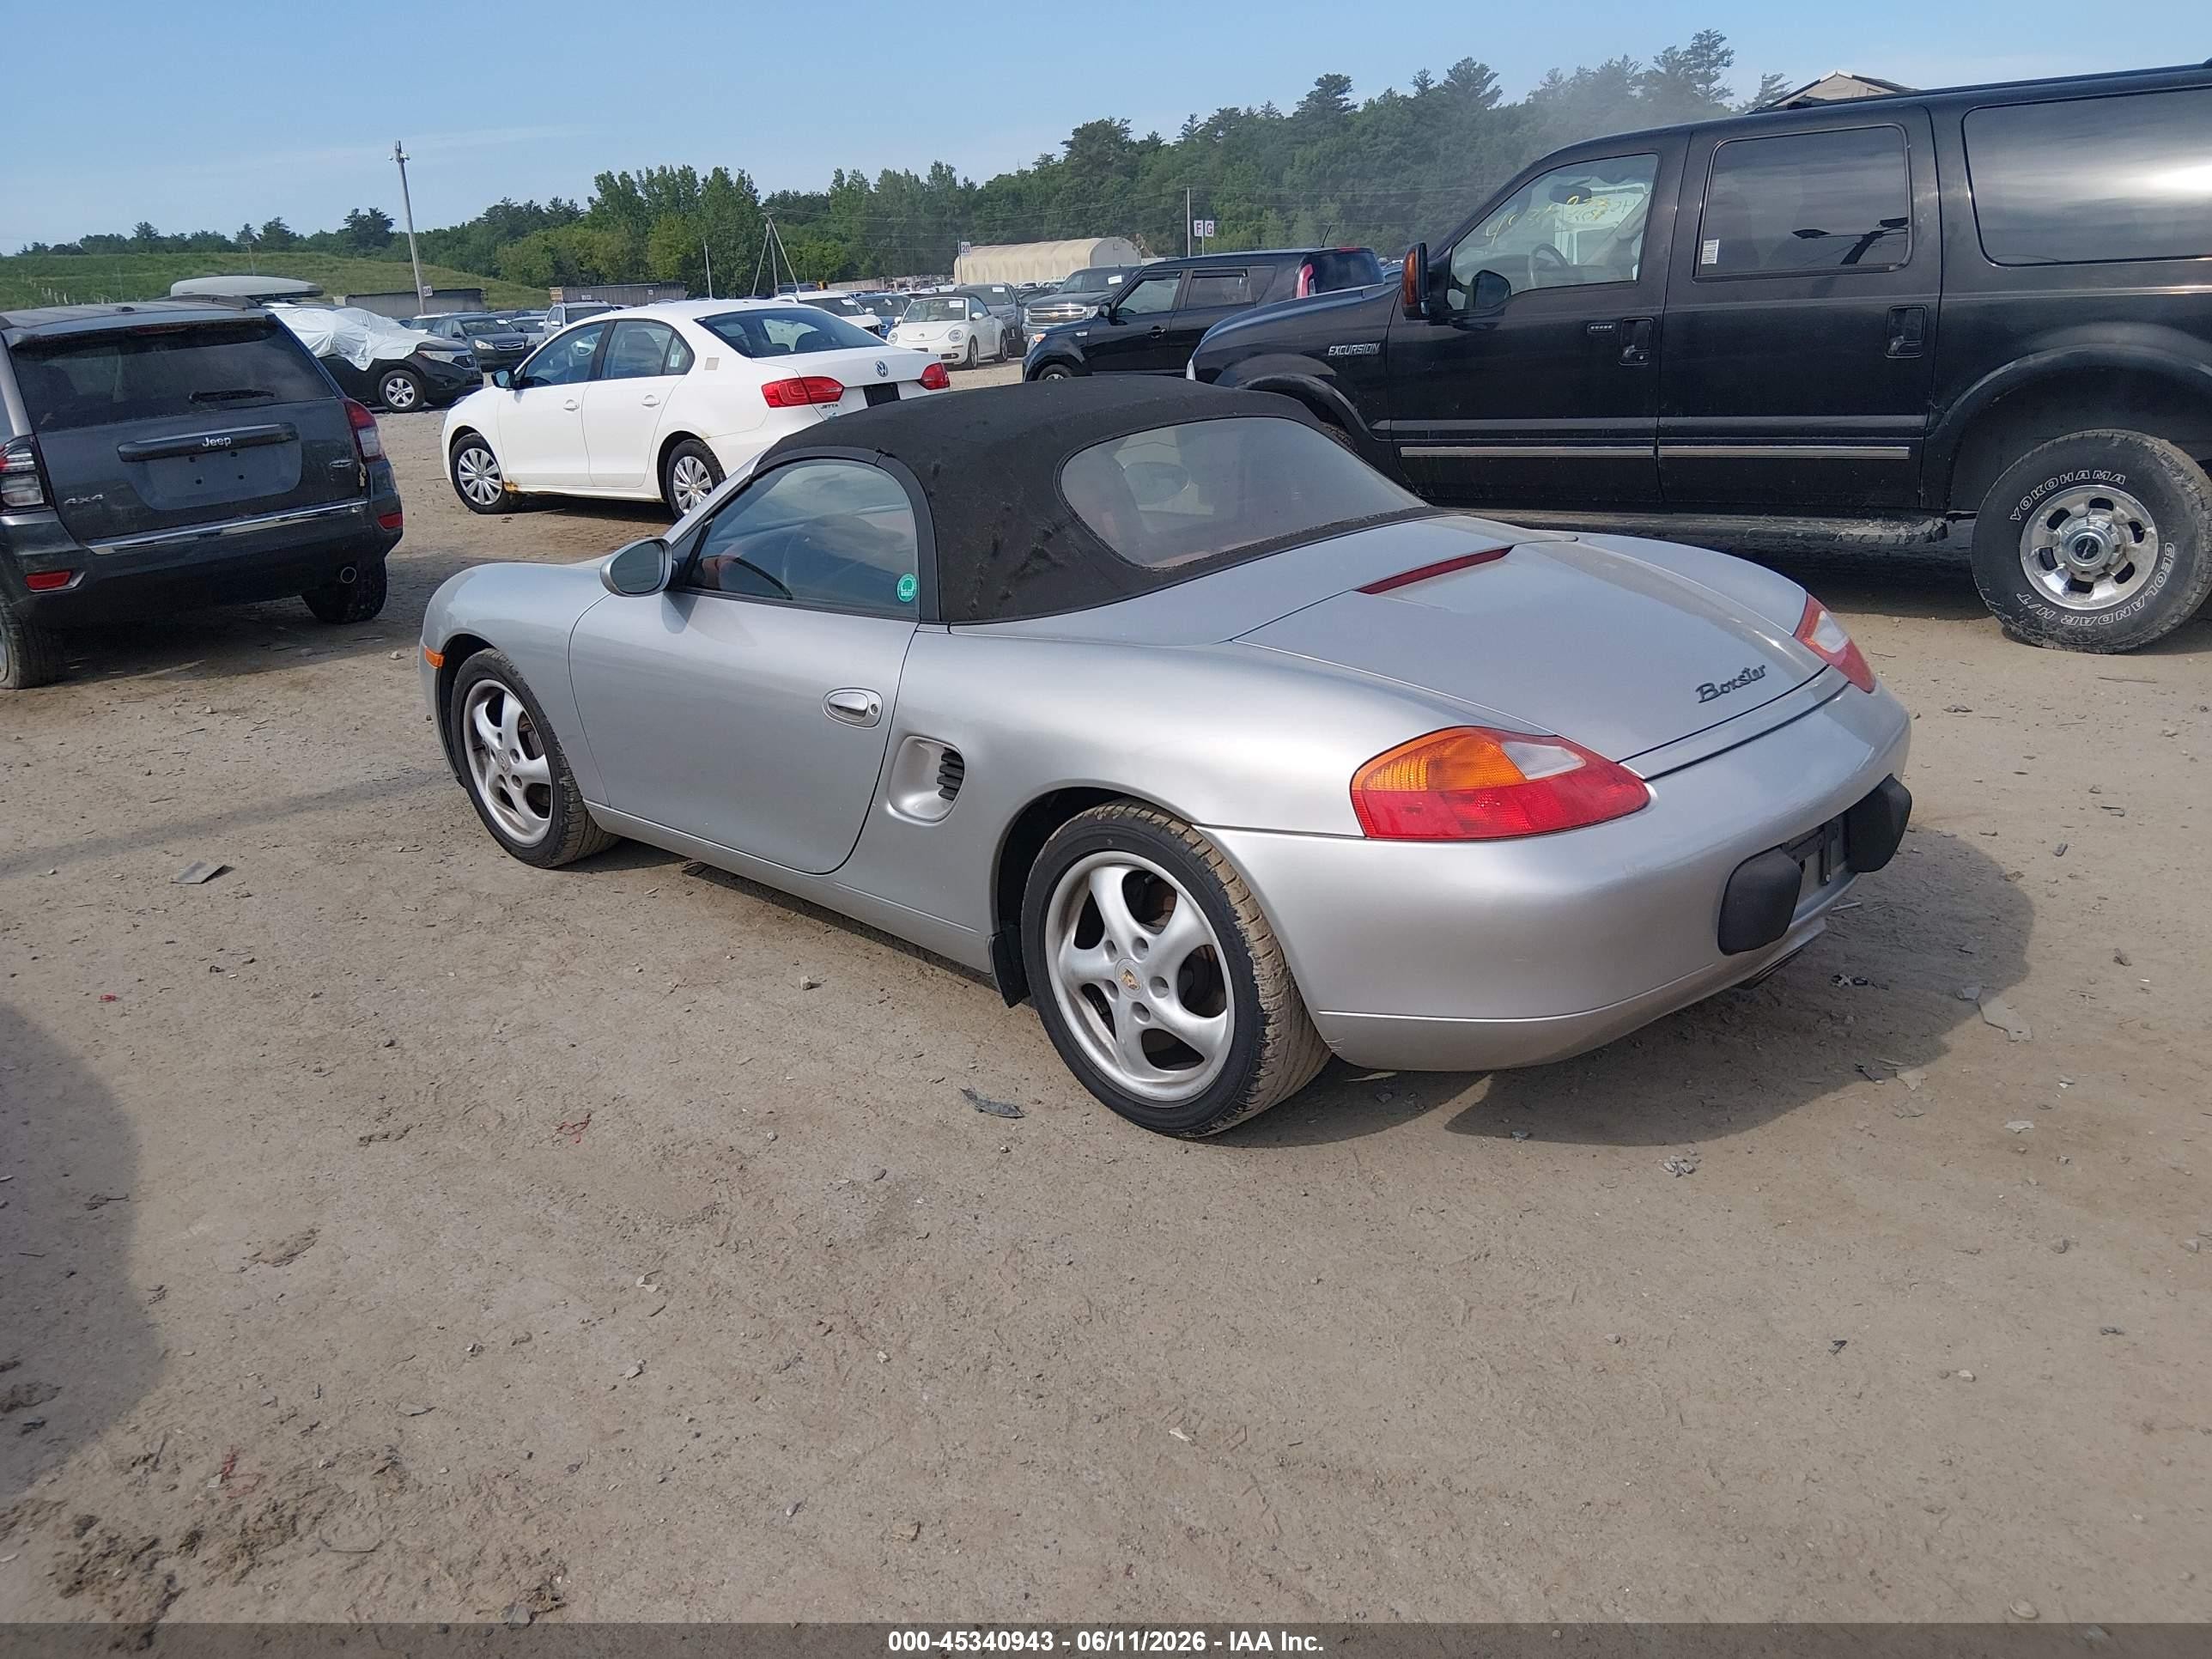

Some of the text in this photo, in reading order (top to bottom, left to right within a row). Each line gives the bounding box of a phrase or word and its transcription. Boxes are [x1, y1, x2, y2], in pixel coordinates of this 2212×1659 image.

[1195, 222, 1201, 234] F
[1206, 222, 1213, 234] G
[962, 244, 970, 253] 20
[1328, 343, 1381, 356] EXCURSION
[202, 436, 232, 447] Jeep
[2009, 470, 2127, 522] YOKOHAMA
[2015, 542, 2175, 626] GEOLANDAR H/T
[1695, 665, 1766, 703] Boxster
